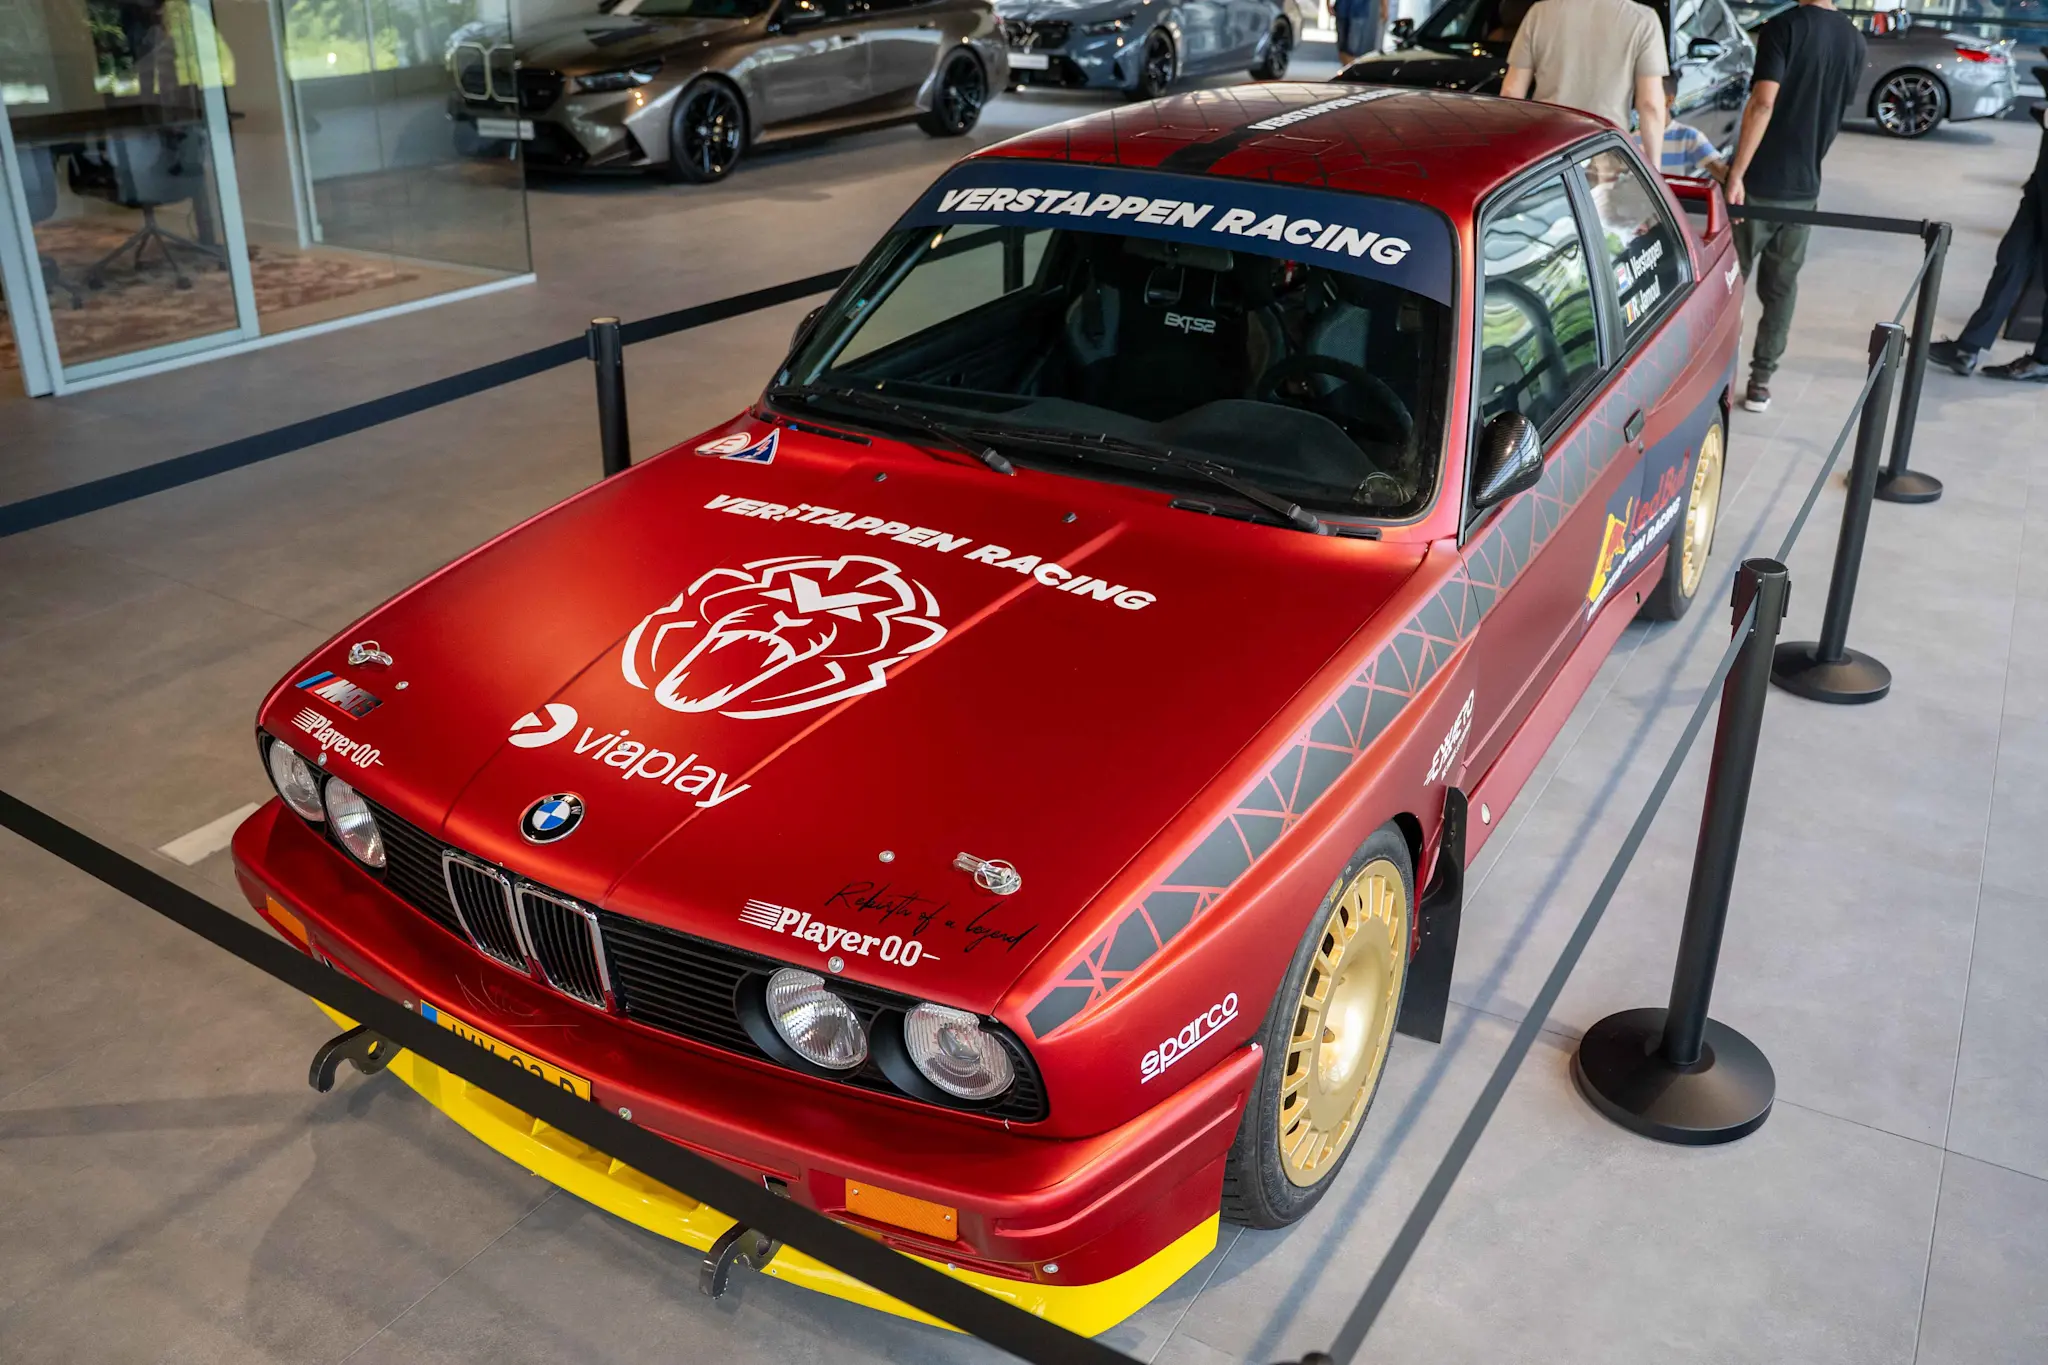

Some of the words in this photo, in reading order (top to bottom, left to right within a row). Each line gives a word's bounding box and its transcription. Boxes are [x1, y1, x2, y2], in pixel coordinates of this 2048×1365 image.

[936, 187, 1213, 228] VERSTAPPEN
[1210, 207, 1412, 265] RACING
[704, 494, 973, 553] VERSTAPPEN
[963, 544, 1158, 611] RACING
[305, 714, 360, 757] Player
[573, 727, 752, 808] viaplay
[772, 906, 881, 956] Player
[913, 902, 950, 936] of
[945, 919, 955, 929] a
[1140, 992, 1238, 1084] sparco
